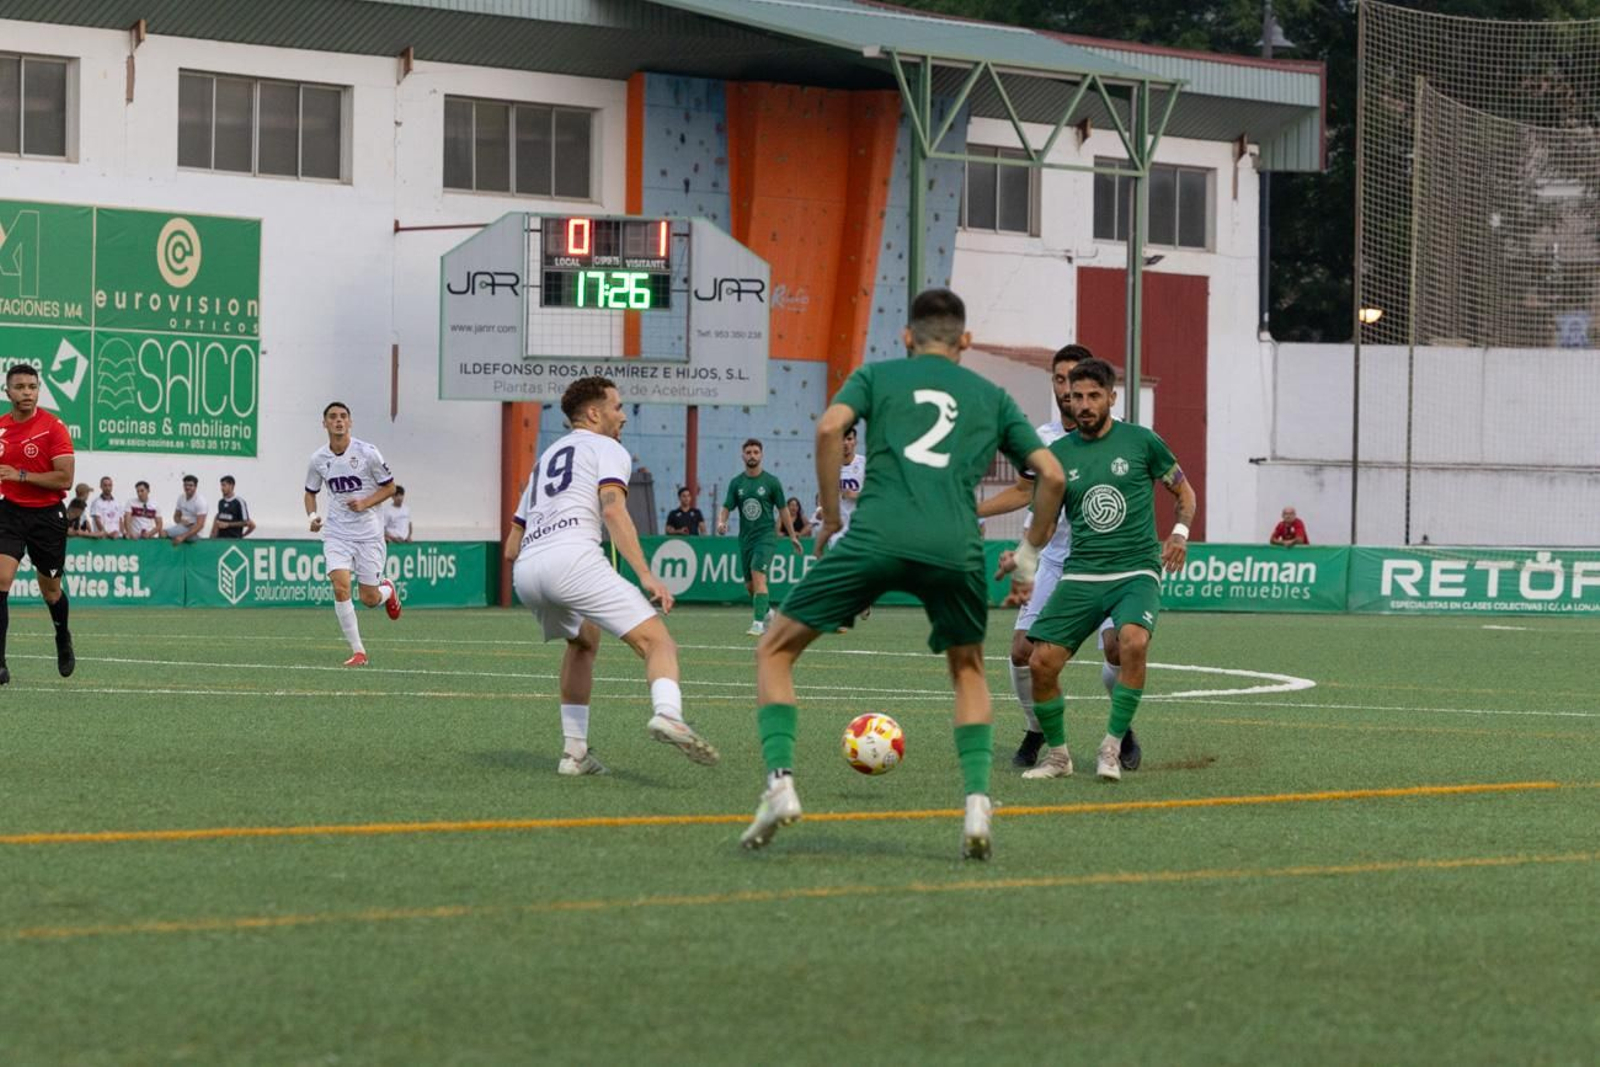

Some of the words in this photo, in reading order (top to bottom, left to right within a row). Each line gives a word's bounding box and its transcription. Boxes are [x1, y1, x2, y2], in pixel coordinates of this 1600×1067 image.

[567, 218, 591, 255] 0
[658, 220, 667, 257] 1
[554, 257, 581, 267] LOCAL
[625, 259, 666, 270] VISITANTE
[576, 271, 652, 309] 17:26
[64, 302, 83, 319] M4
[95, 290, 259, 318] eurovision
[138, 338, 257, 417] SAICO
[459, 362, 544, 376] ILDEFONSO
[549, 364, 589, 376] ROSA
[594, 364, 658, 379] RAMÍREZ
[663, 367, 672, 379] E
[676, 367, 721, 381] HIJOS,
[726, 368, 749, 380] S.L.
[493, 381, 543, 394] Plantas
[630, 383, 648, 396] de
[652, 384, 719, 398] Aceitunas
[99, 416, 156, 435] cocinas
[161, 417, 173, 435] &
[178, 419, 252, 439] mobiliario
[904, 388, 959, 468] 2
[530, 445, 575, 510] 19
[254, 547, 276, 580] El
[403, 554, 414, 578] e
[416, 547, 456, 586] hijos
[65, 575, 109, 597] Vico
[113, 575, 151, 597] S.L.
[255, 580, 306, 601] soluciones
[1201, 583, 1223, 598] de
[1230, 584, 1311, 600] muebles
[1390, 601, 1448, 610] ESPECIALISTAS
[1450, 601, 1461, 610] EN
[1462, 602, 1492, 610] CLASES
[1493, 602, 1543, 611] COLECTIVAS
